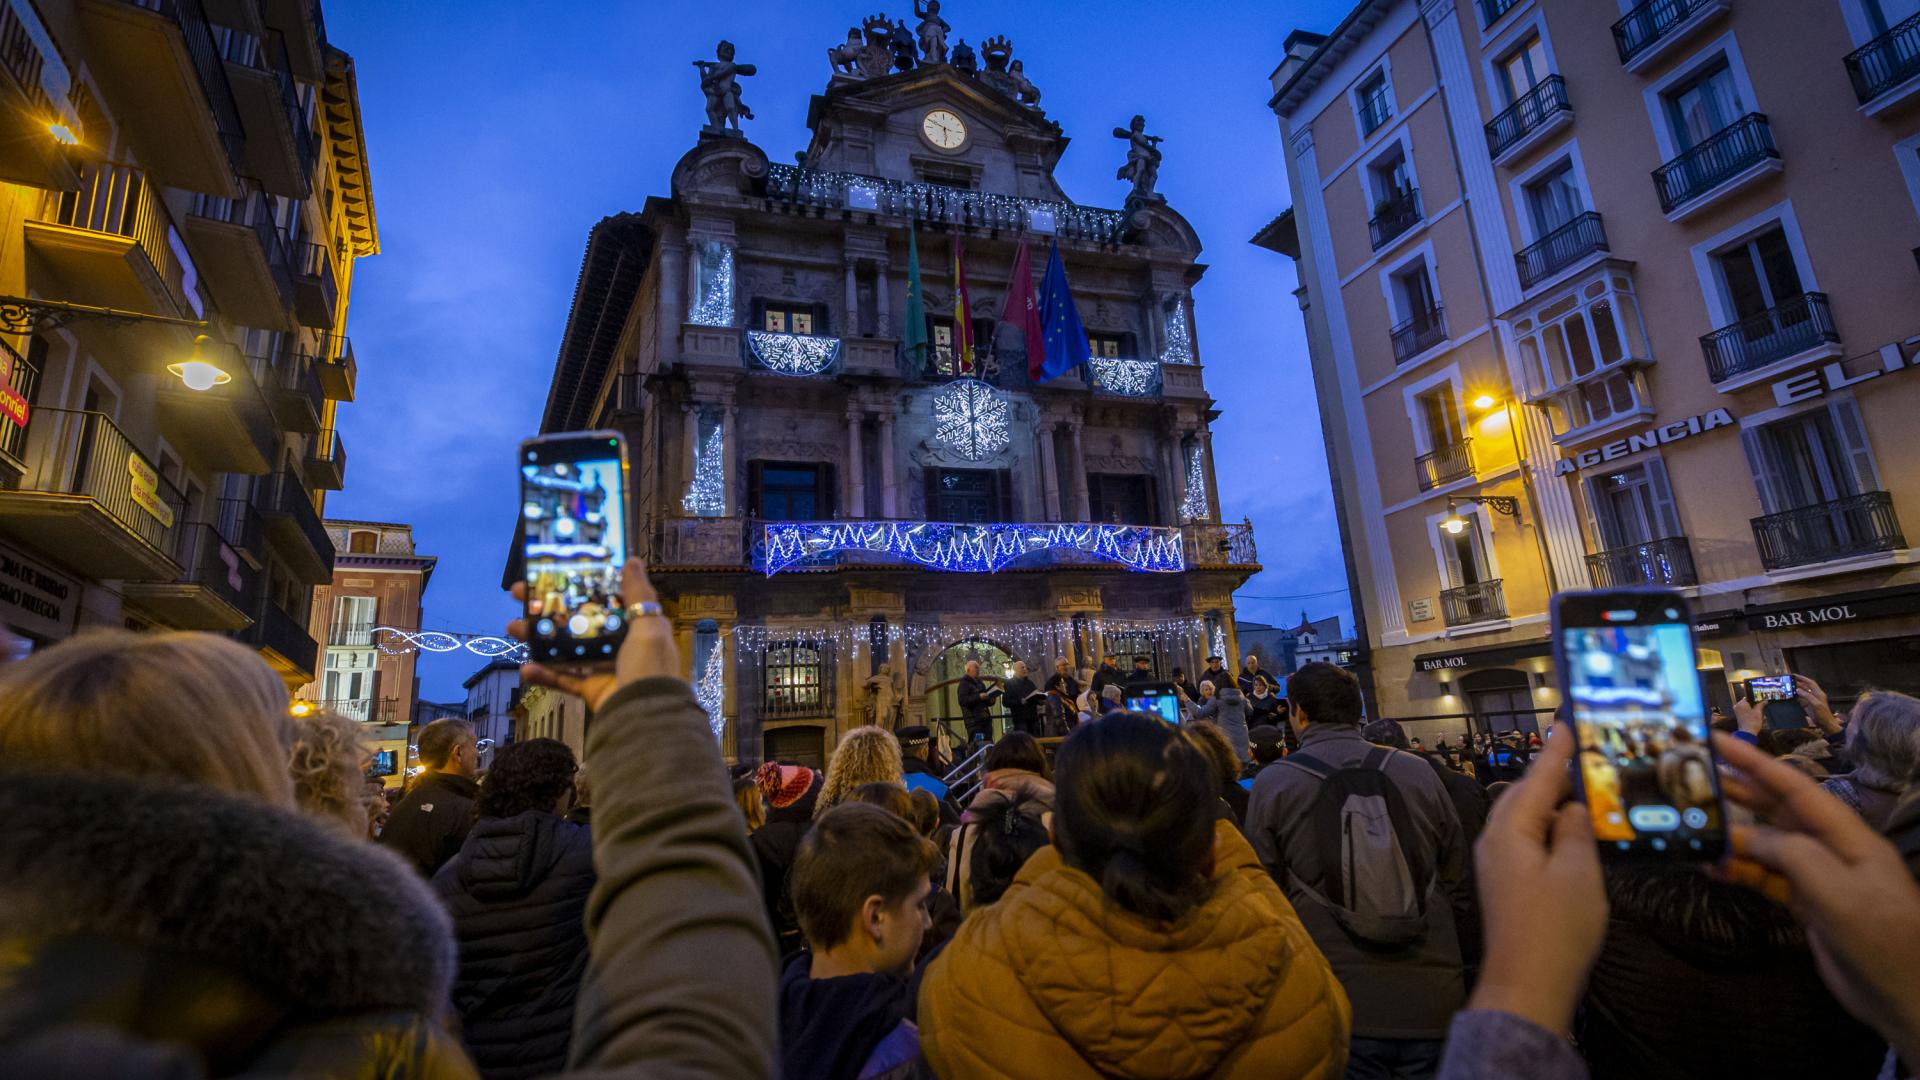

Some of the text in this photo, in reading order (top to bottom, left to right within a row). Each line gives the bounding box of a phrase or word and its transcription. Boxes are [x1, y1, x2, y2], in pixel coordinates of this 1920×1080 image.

[1553, 408, 1734, 477] AGENCIA
[1764, 605, 1857, 628] BAR MOL
[1423, 656, 1467, 670] BAR MOL
